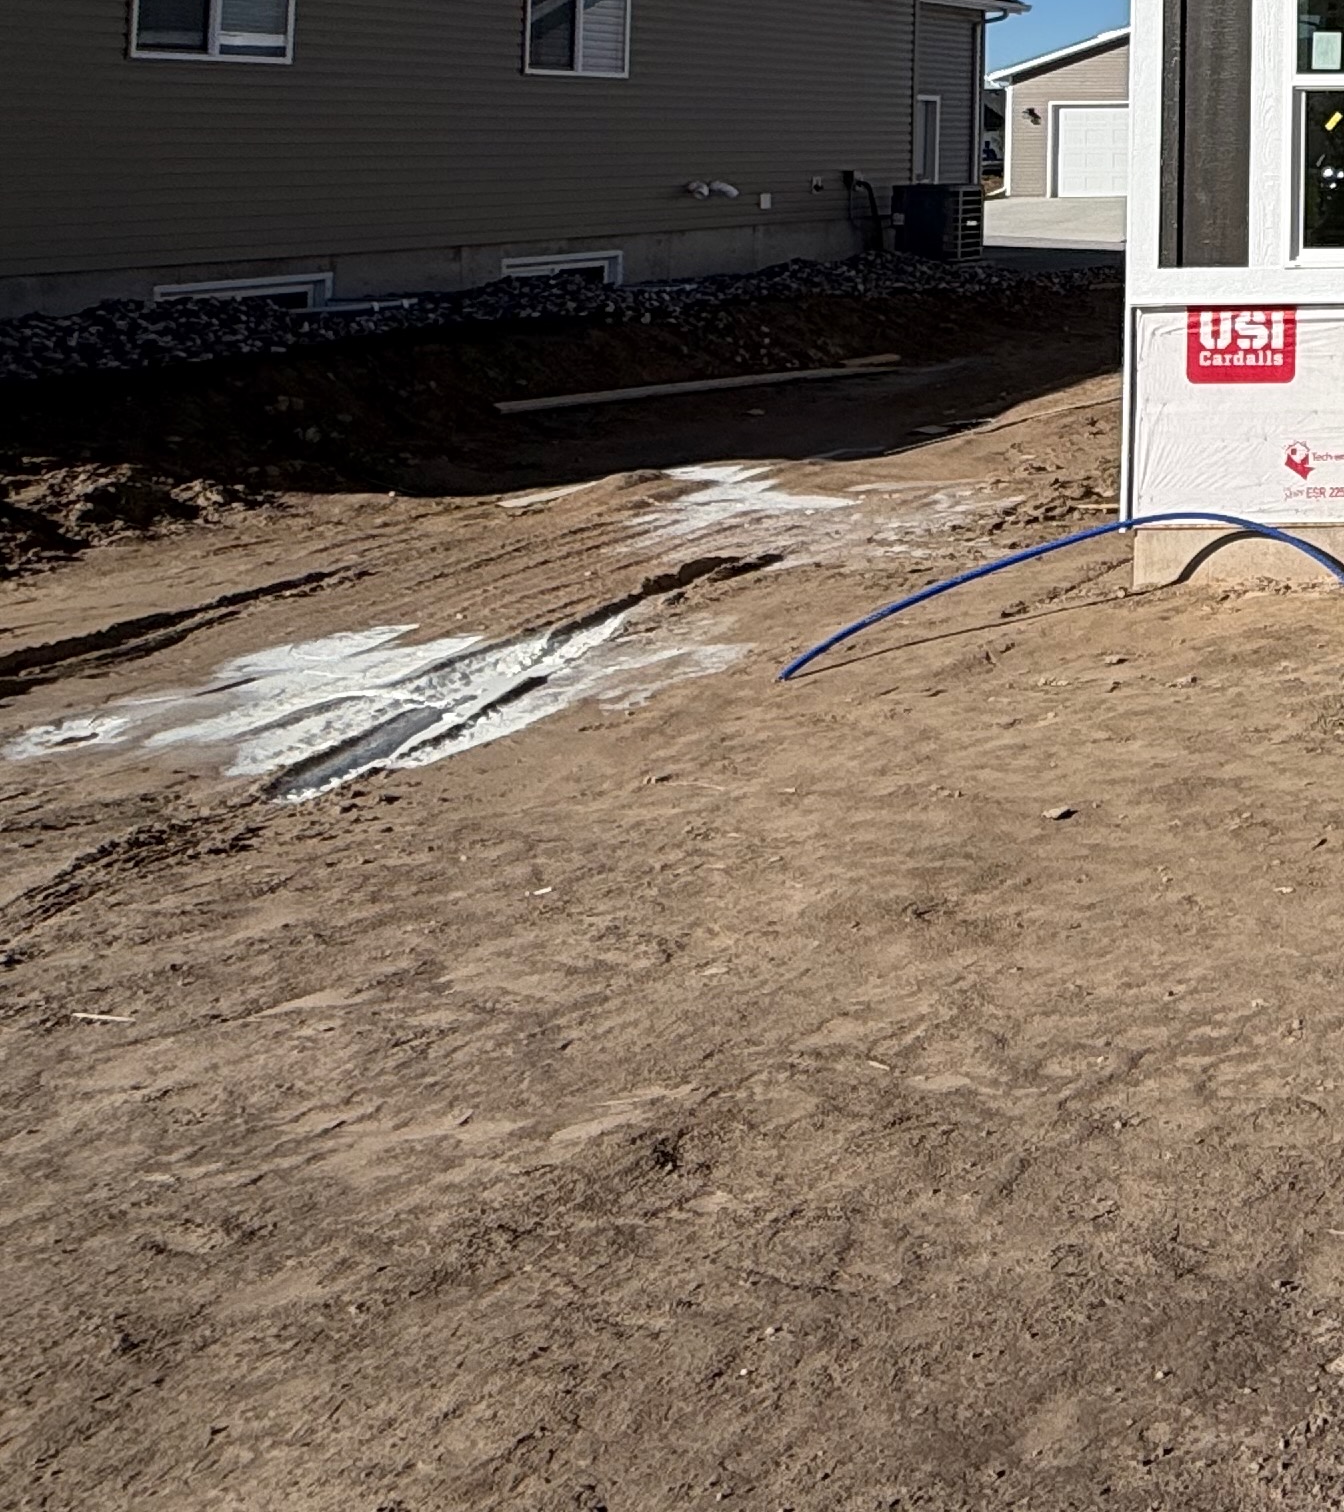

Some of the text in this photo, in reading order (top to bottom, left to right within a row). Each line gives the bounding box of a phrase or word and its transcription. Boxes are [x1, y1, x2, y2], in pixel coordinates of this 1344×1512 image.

[1200, 311, 1284, 350] USI
[1199, 350, 1284, 367] Cardalls
[1306, 487, 1327, 499] ESR
